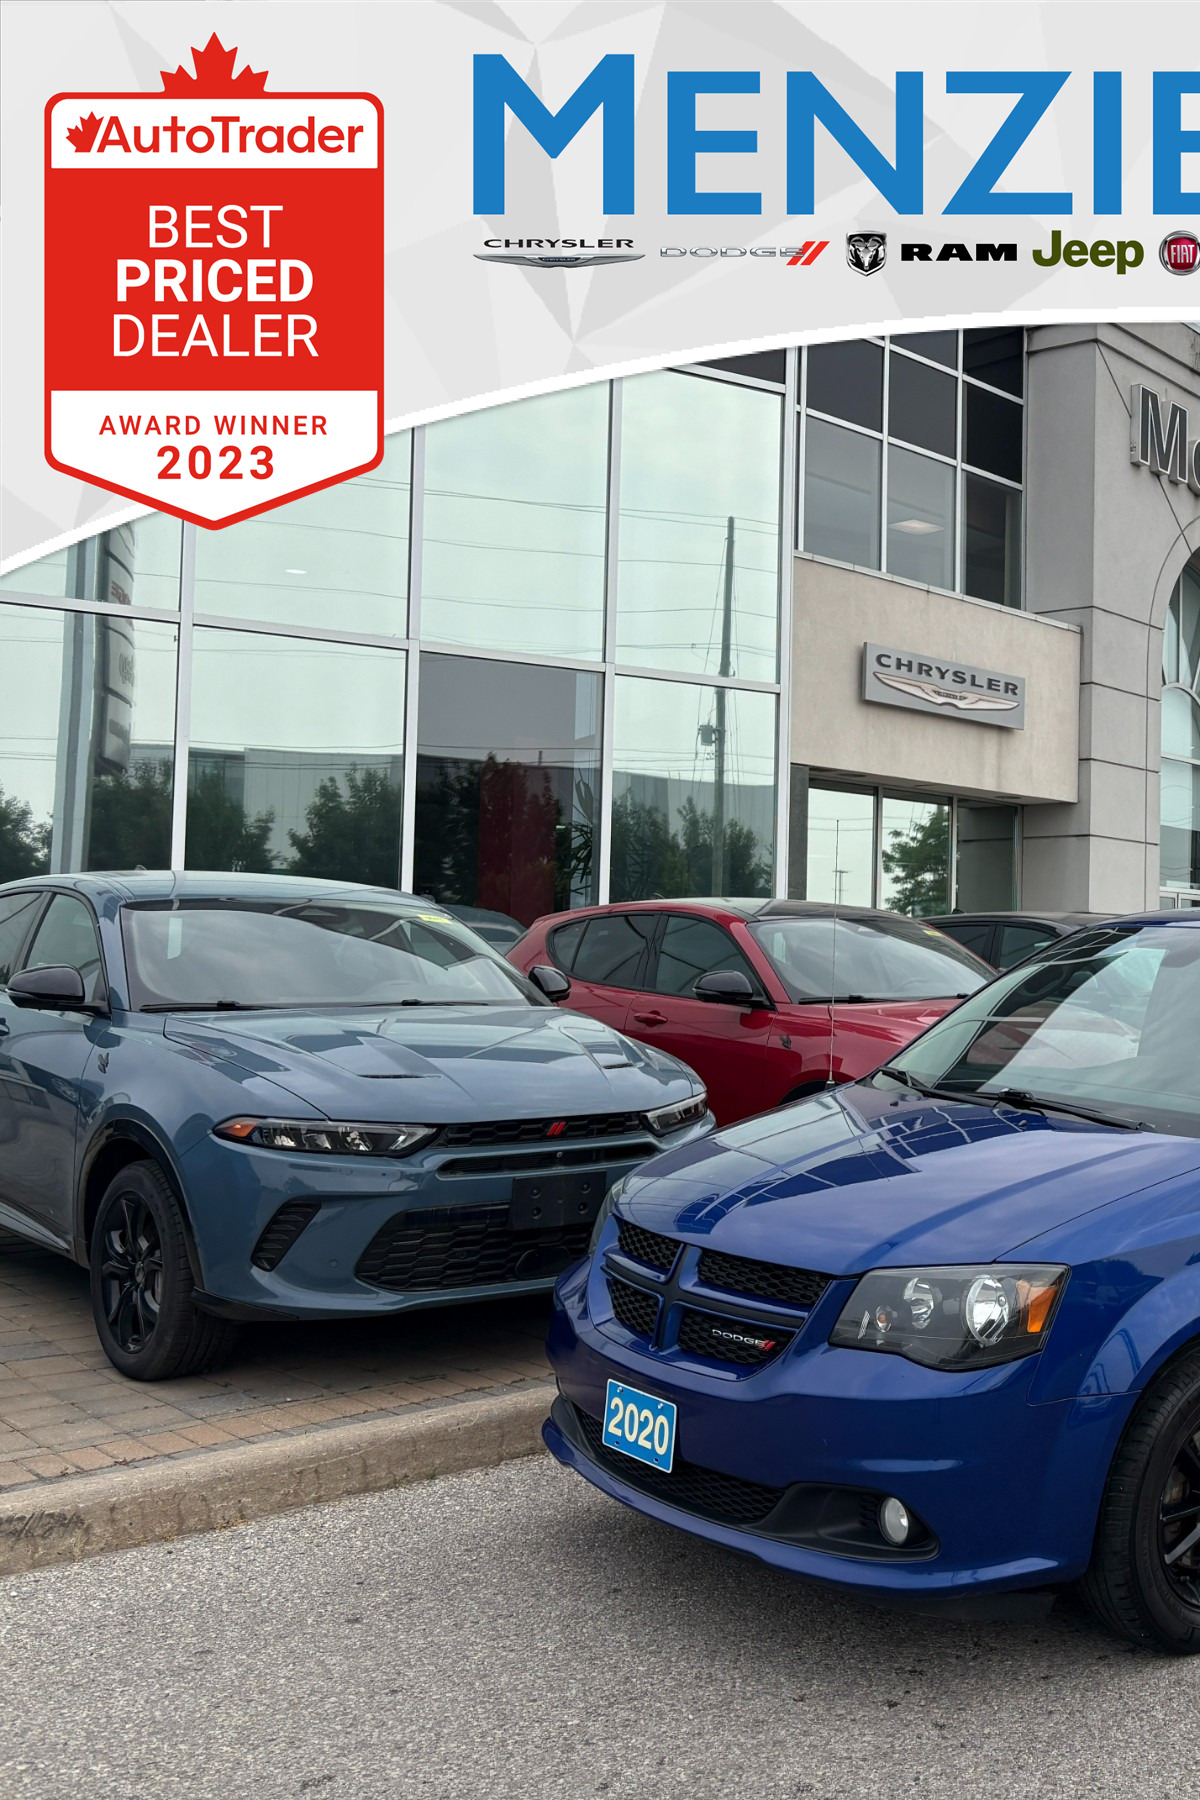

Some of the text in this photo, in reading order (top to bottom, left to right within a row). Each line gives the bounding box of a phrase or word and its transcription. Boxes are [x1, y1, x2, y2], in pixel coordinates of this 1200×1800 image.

[876, 653, 1019, 696] CHRYSLER
[711, 1328, 767, 1347] DODGE
[607, 1396, 670, 1456] 2020
